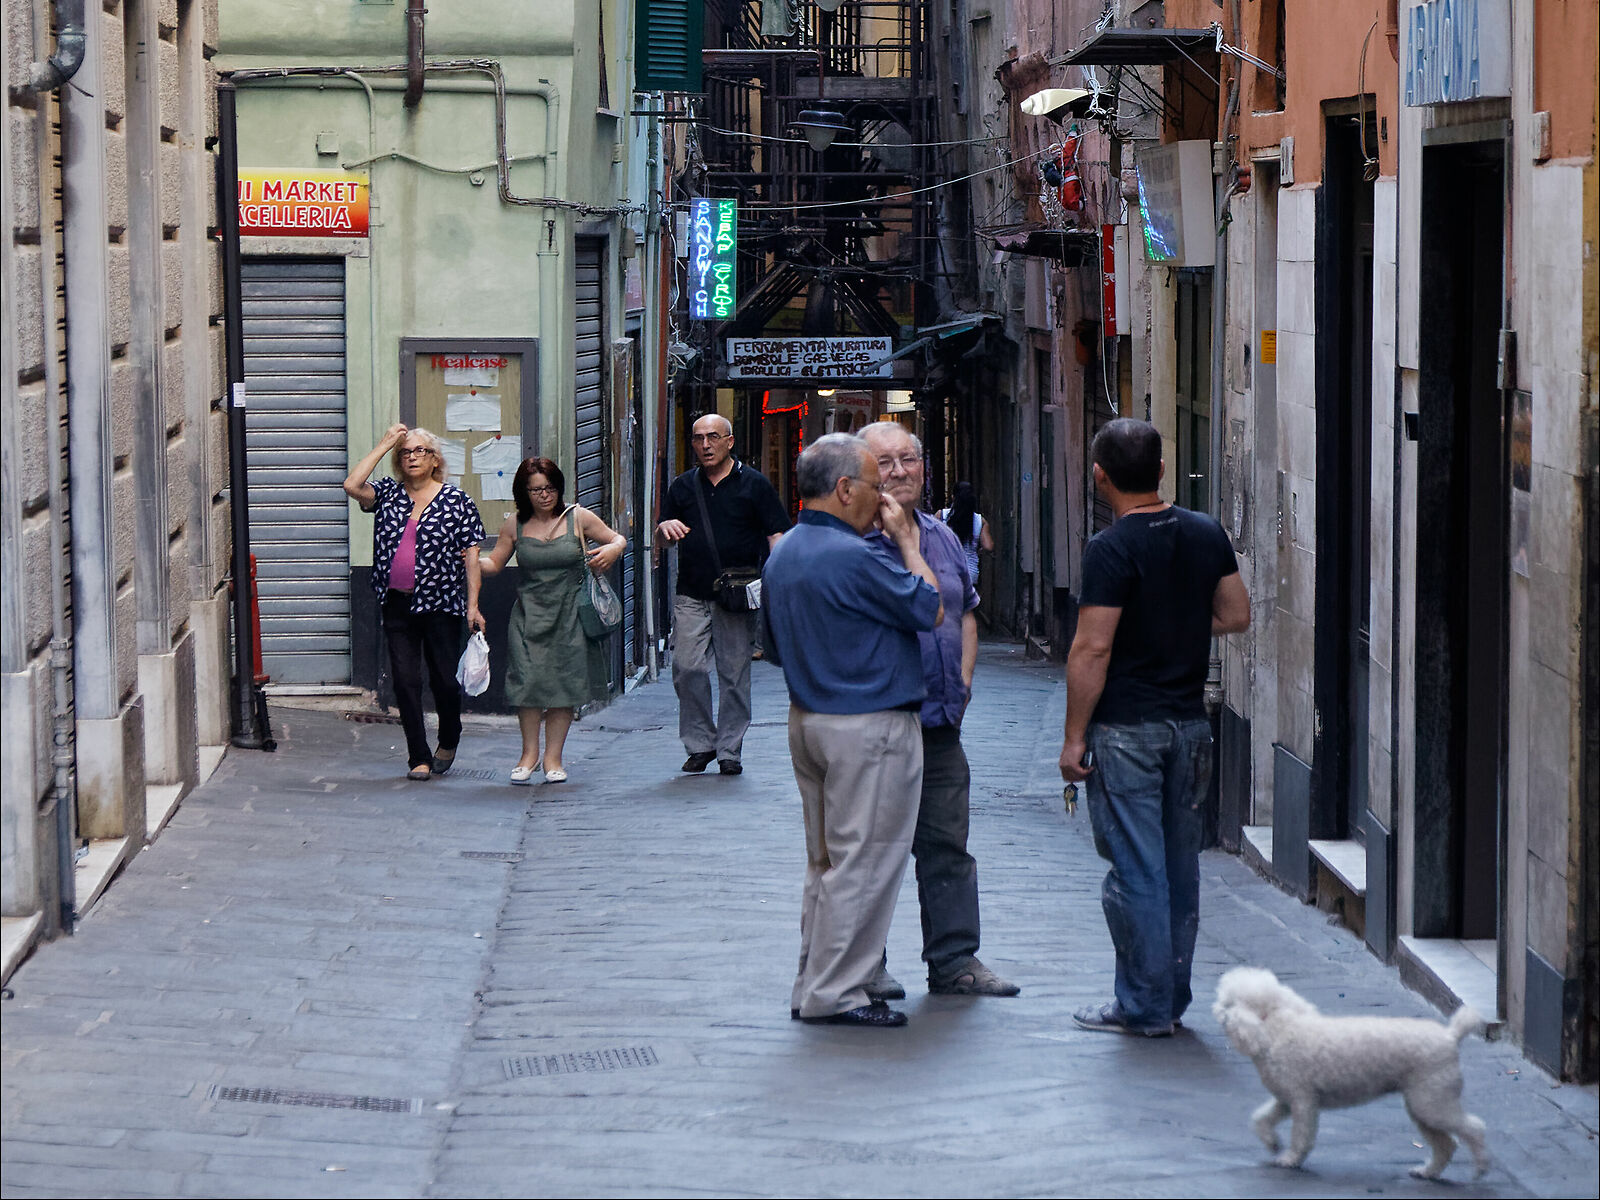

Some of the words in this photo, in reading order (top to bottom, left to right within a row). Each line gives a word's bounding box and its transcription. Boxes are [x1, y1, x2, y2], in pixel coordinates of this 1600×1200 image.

[262, 180, 359, 202] MARKET
[695, 201, 712, 317] SANDWICH
[734, 341, 827, 354] FERRAMENTA
